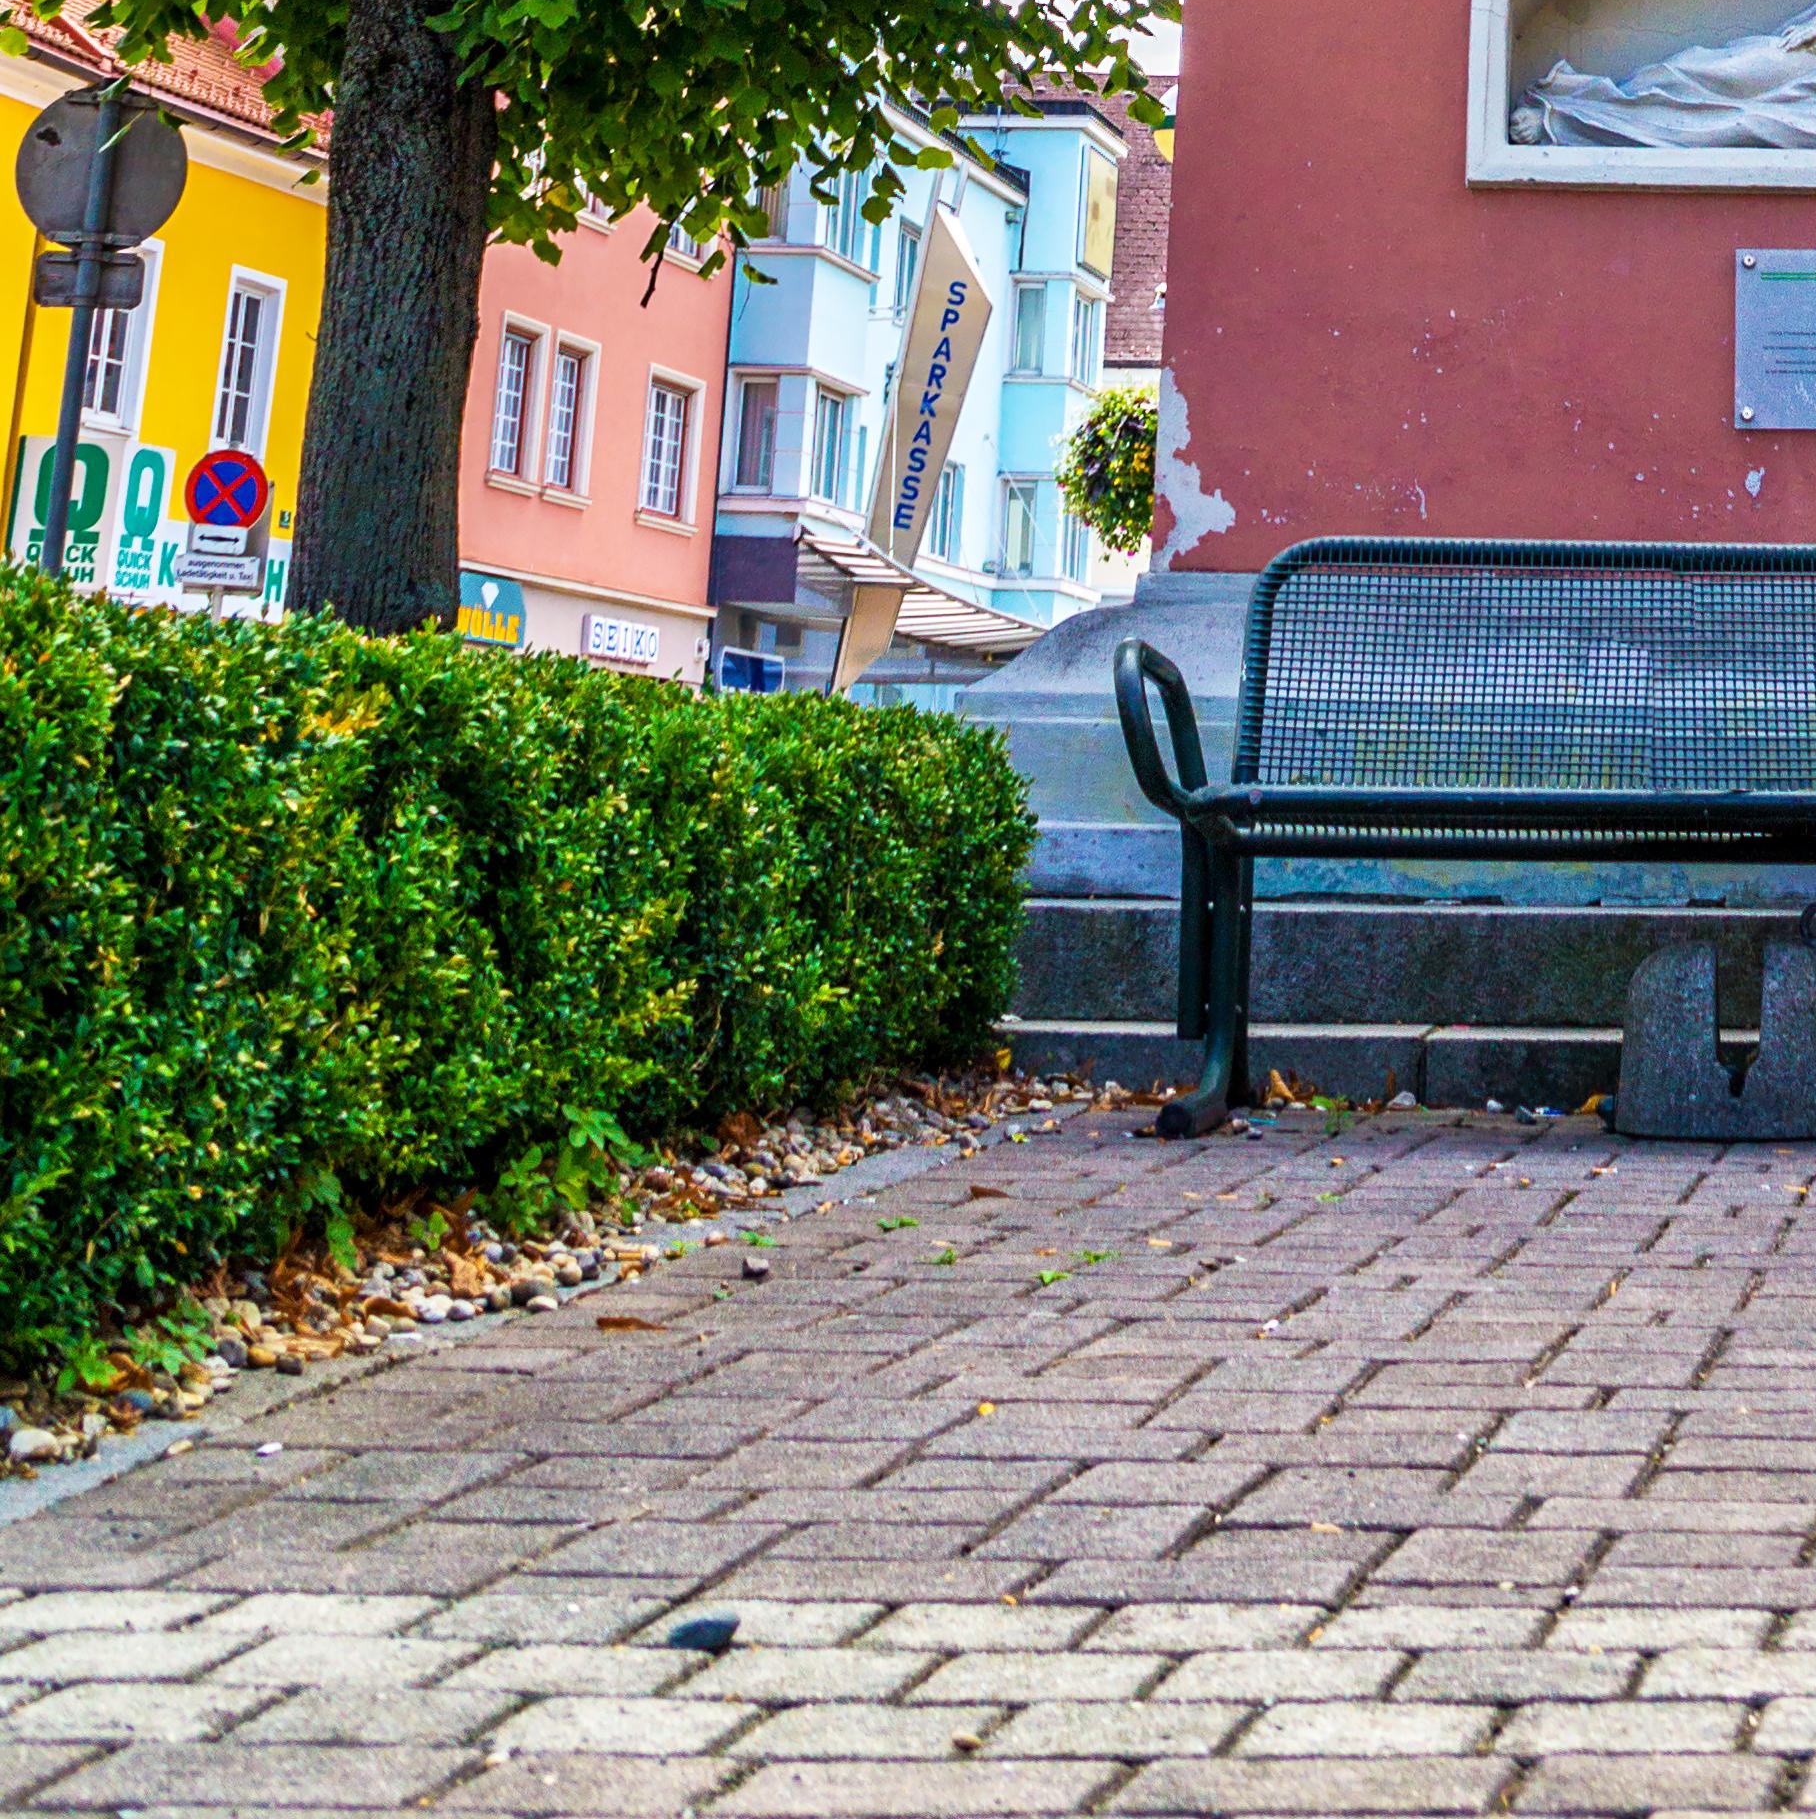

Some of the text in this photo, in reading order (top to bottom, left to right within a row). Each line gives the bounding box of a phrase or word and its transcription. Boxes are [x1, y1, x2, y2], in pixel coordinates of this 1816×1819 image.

[892, 280, 968, 530] SPARKASSE
[26, 543, 97, 564] QCK
[117, 548, 152, 570] QUICK
[114, 570, 150, 590] SCHUH
[592, 621, 658, 658] SEIKO
